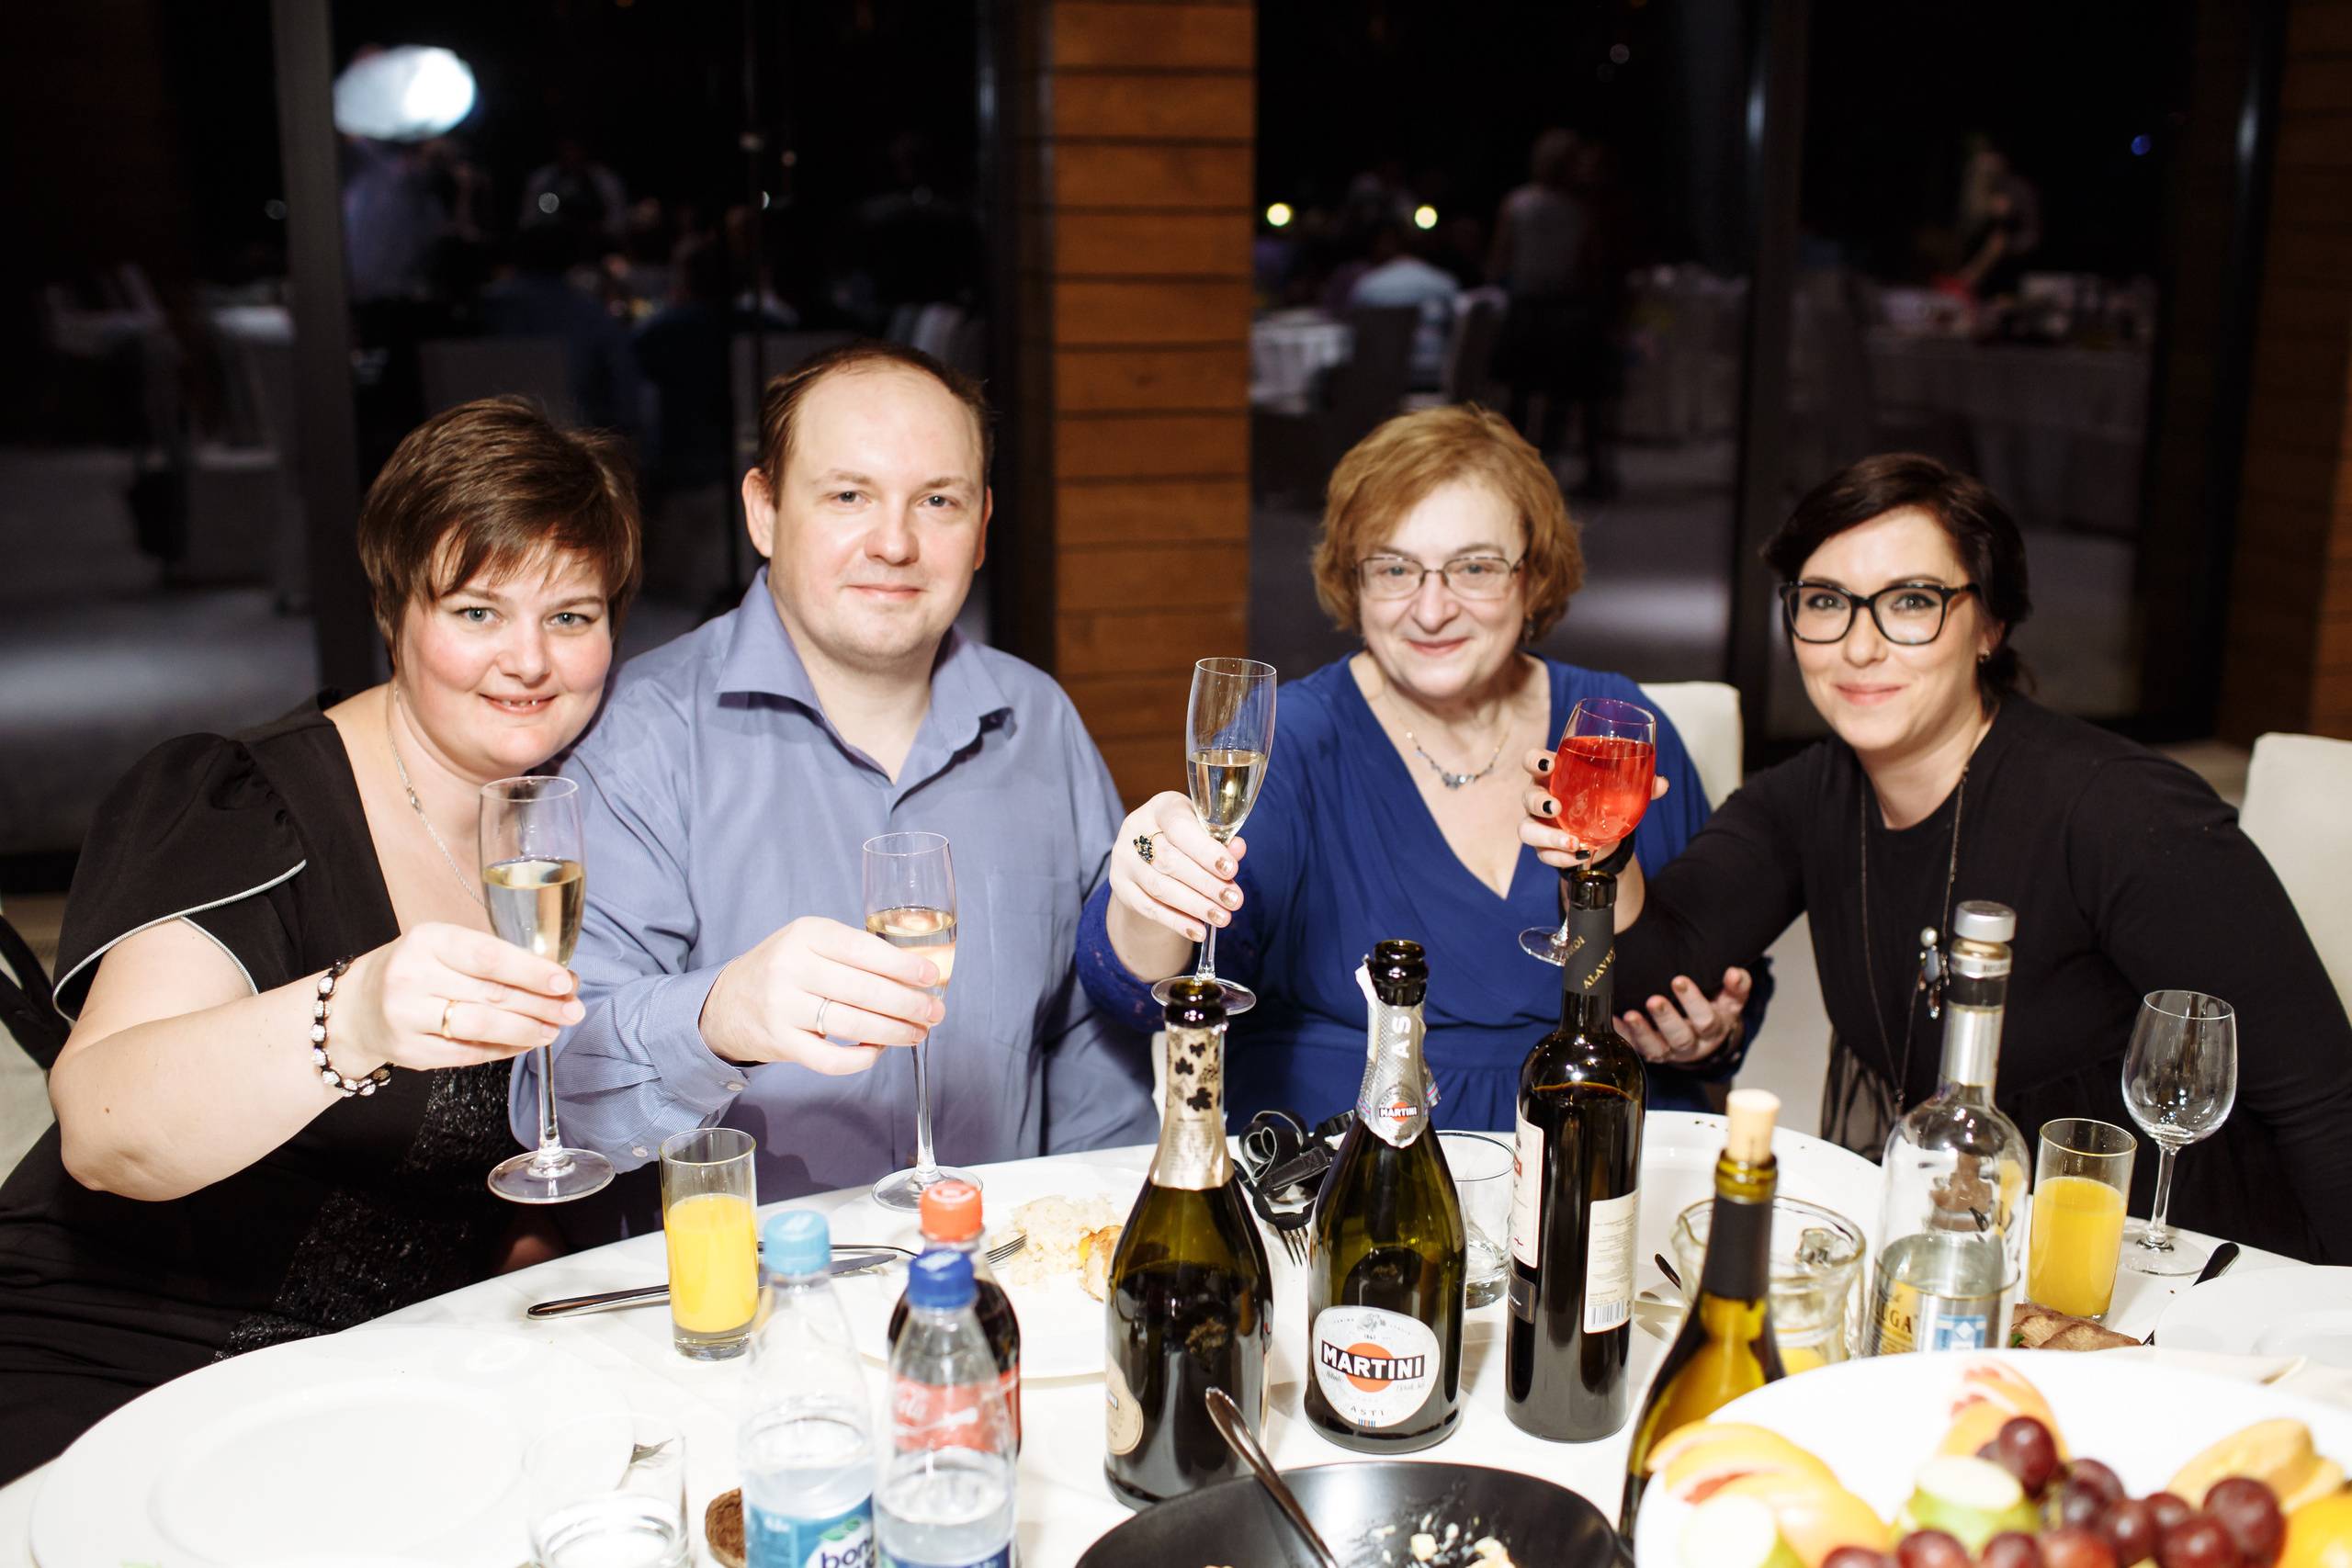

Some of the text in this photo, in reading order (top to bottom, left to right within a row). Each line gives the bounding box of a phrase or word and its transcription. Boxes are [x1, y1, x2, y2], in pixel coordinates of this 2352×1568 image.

[1391, 1005, 1412, 1059] AS
[1379, 1106, 1418, 1117] MARTINI
[1322, 1343, 1422, 1380] MARTINI
[1351, 1405, 1385, 1416] ASTI
